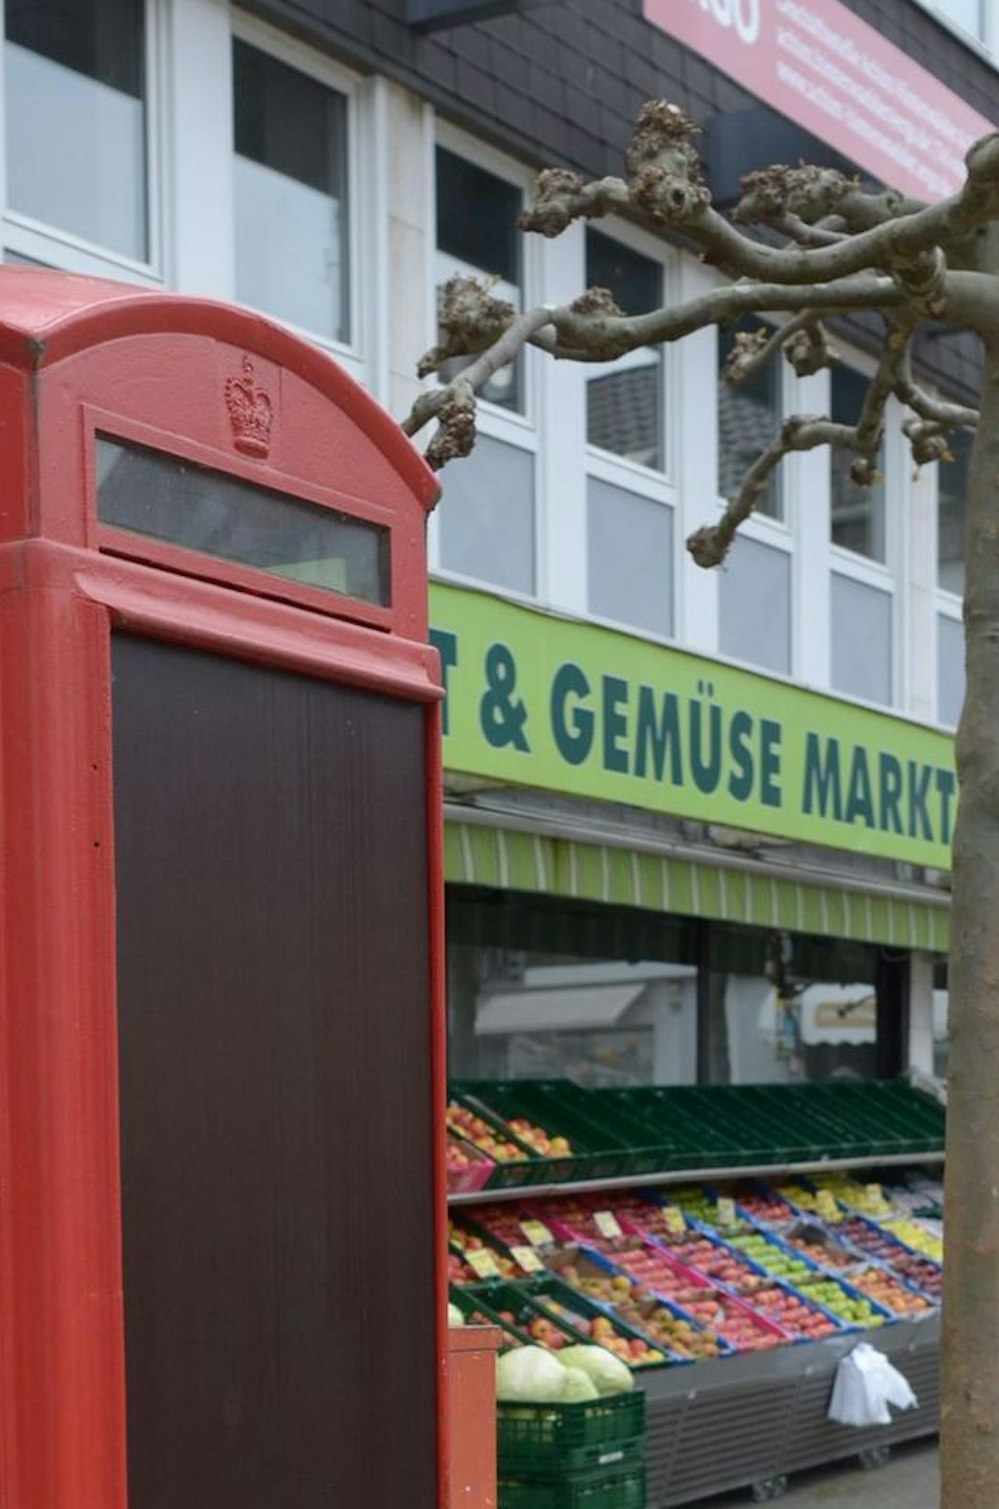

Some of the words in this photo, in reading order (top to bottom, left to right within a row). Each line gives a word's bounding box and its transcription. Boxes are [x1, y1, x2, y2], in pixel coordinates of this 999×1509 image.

[480, 643, 530, 753] &
[551, 663, 782, 807] GEMÜSE
[803, 732, 956, 845] MARKT
